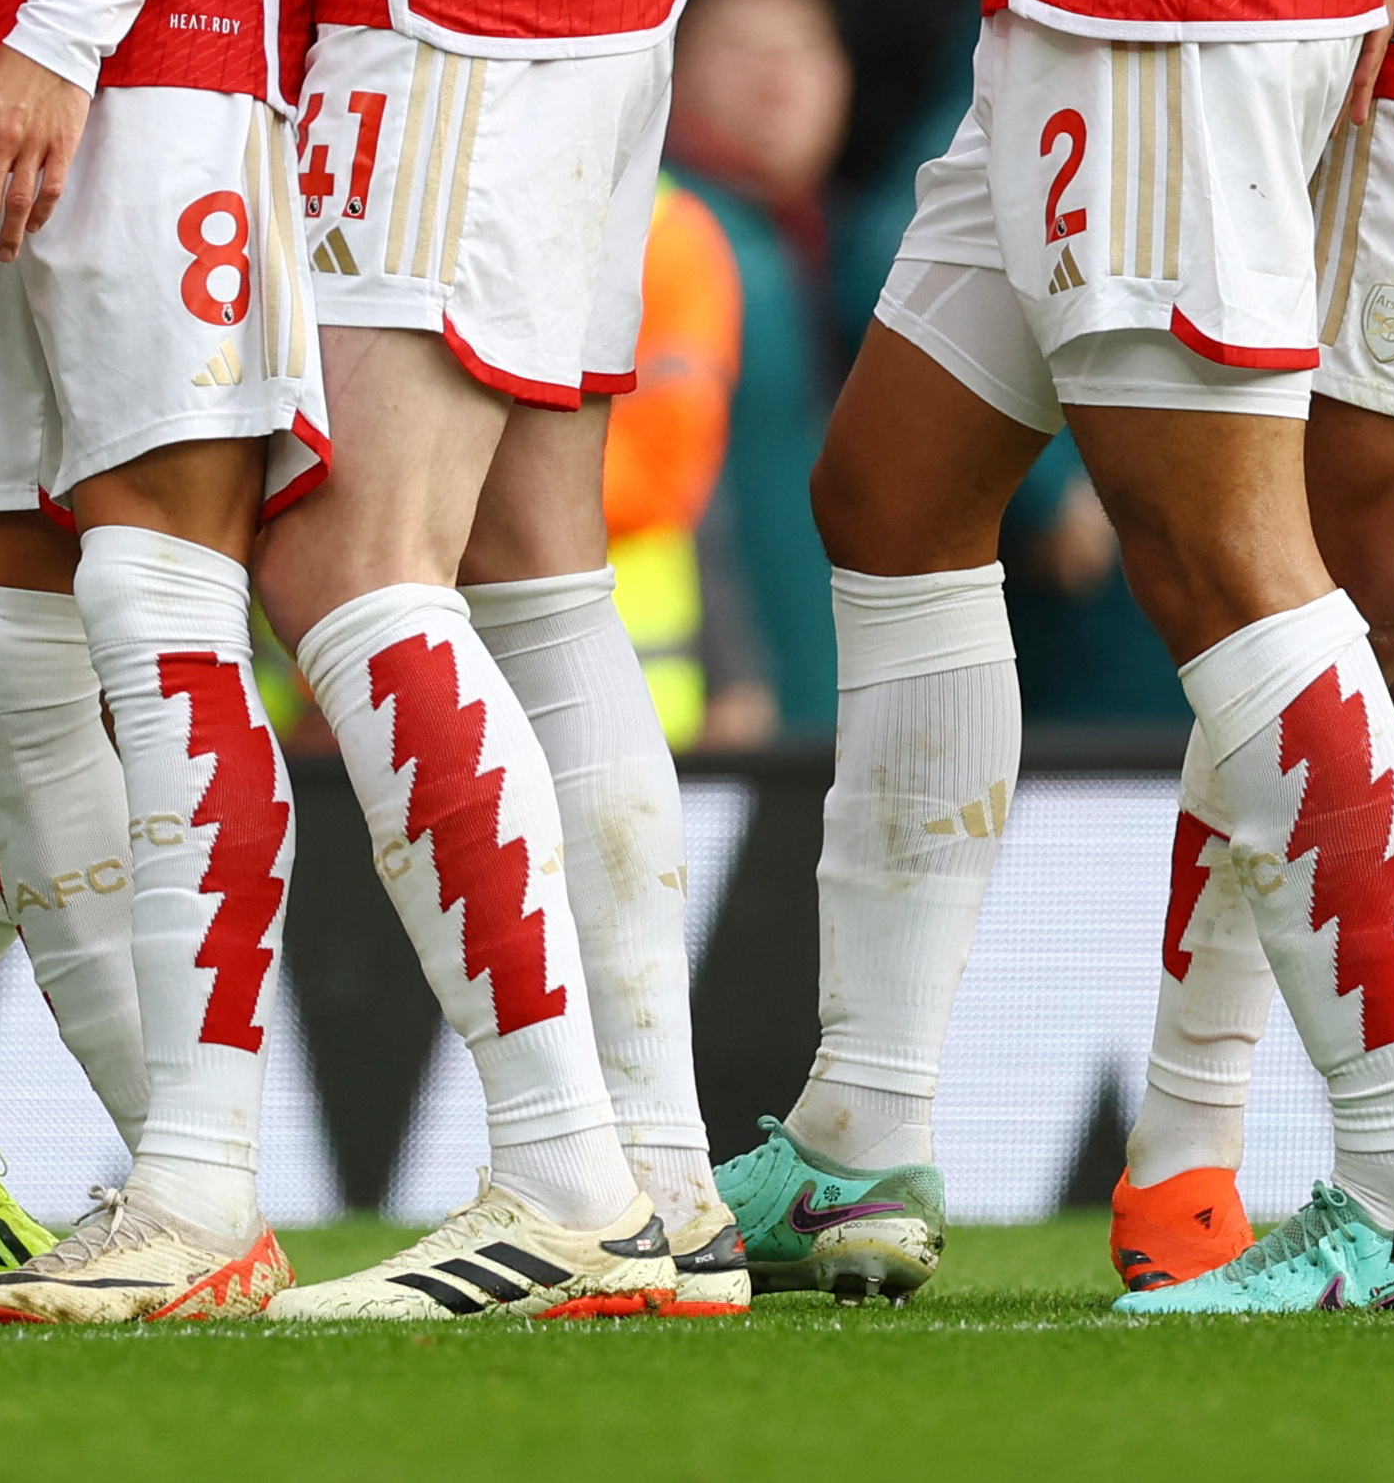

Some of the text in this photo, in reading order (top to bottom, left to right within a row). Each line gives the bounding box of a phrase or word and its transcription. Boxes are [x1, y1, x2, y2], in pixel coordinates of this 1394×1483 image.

[169, 12, 242, 36] HEAT.RDY
[297, 90, 388, 221] 41
[1039, 107, 1088, 247] 2
[176, 189, 252, 327] 8
[15, 857, 128, 914] AFC
